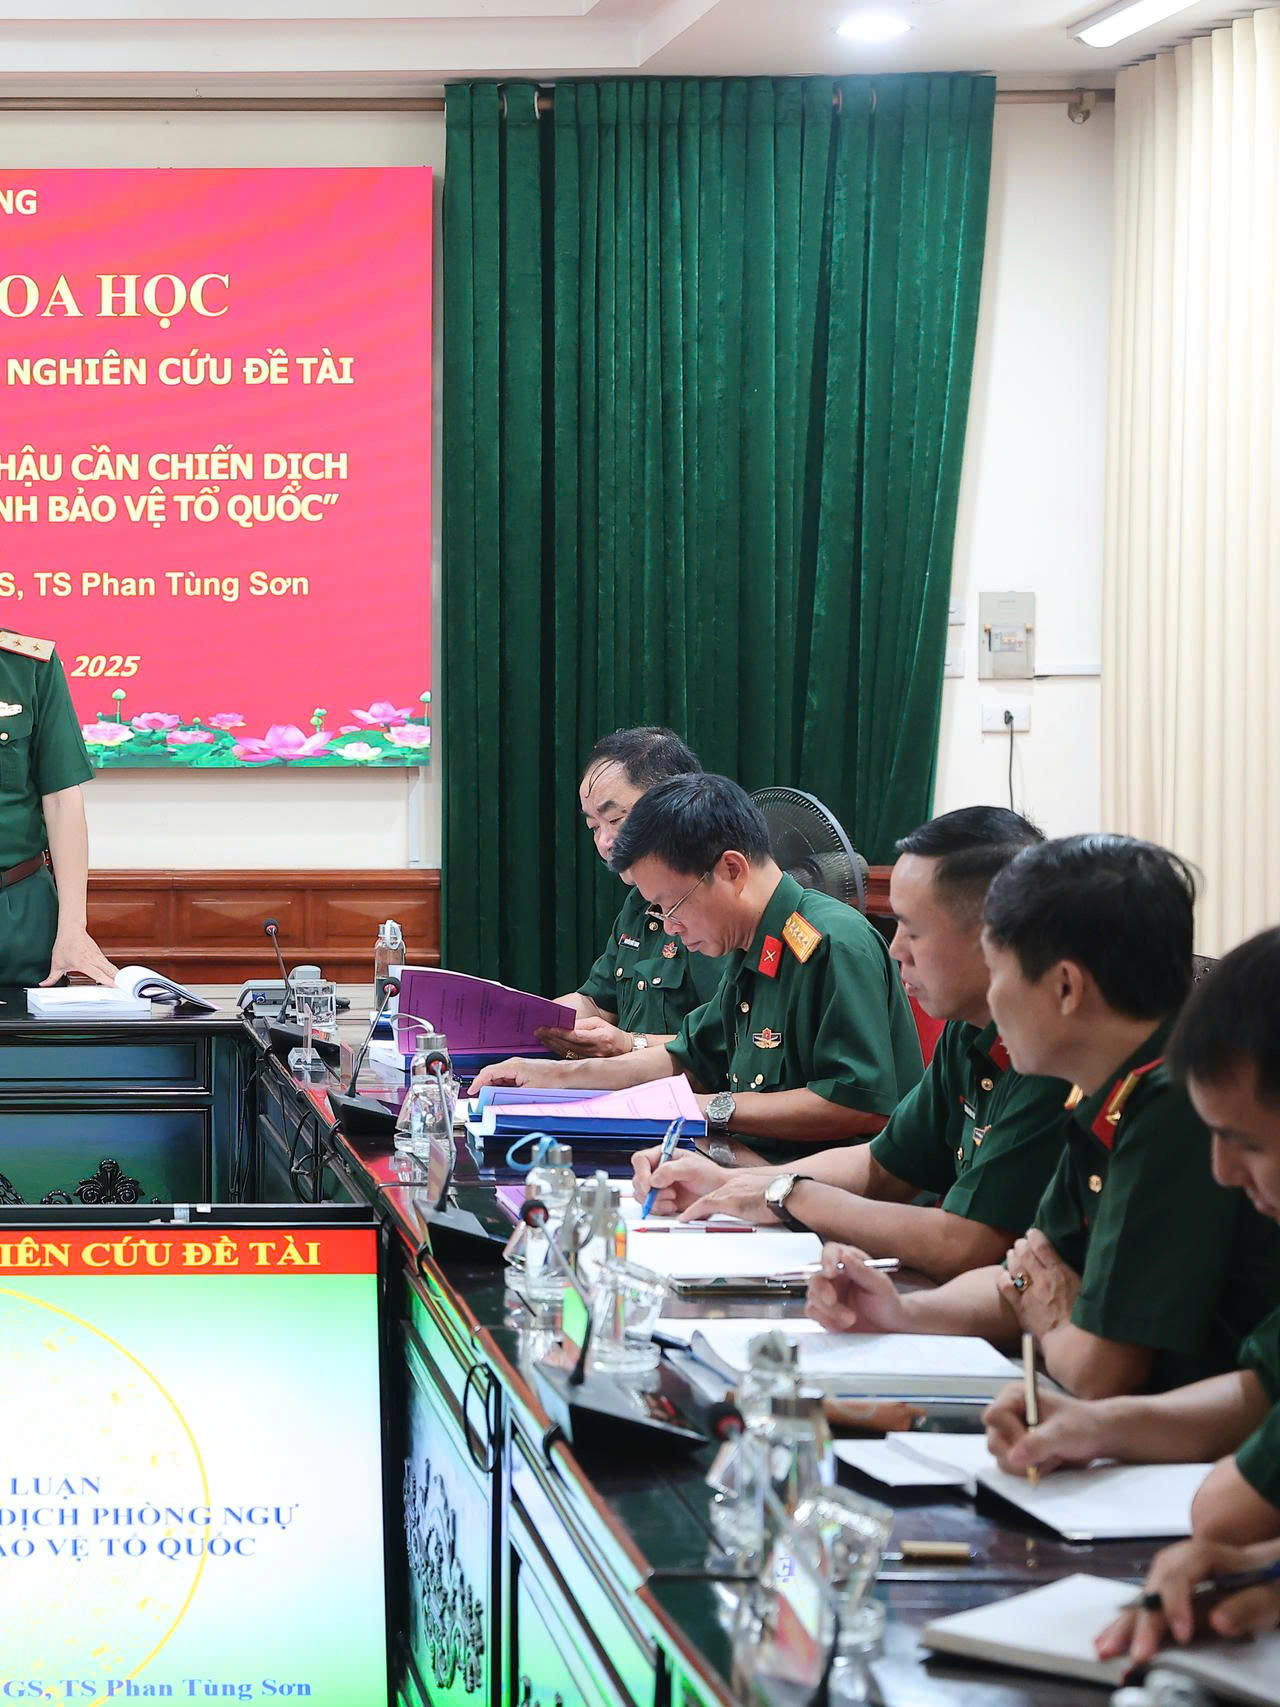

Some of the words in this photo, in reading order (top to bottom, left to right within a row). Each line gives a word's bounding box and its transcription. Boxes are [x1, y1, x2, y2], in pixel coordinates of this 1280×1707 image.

[96, 273, 229, 329] HỌC
[7, 349, 147, 386] NGHIÊN
[158, 349, 232, 386] CỨU
[242, 348, 289, 385] ĐỀ
[295, 348, 354, 385] TÀI
[71, 445, 139, 481] CẦN
[147, 444, 253, 481] CHIẾN
[263, 453, 348, 487] DỊCH
[48, 486, 117, 523] BẢO
[123, 487, 166, 529] VỆ
[173, 485, 221, 522] TỔ
[33, 571, 72, 597] TS
[82, 572, 156, 597] Phan
[164, 571, 240, 602] Tùng
[249, 571, 309, 596] Sơn
[70, 655, 142, 678] 2025
[81, 1236, 175, 1267] CỨU
[182, 1235, 239, 1266] ĐỀ
[249, 1235, 321, 1266] TÀI
[91, 1502, 212, 1526] PHÒNG
[223, 1502, 300, 1530] NGỰ
[3, 1680, 53, 1700] GS,
[60, 1680, 97, 1697] TS
[106, 1679, 173, 1697] Phan
[182, 1679, 252, 1700] Tùng
[261, 1679, 312, 1697] Sơn
